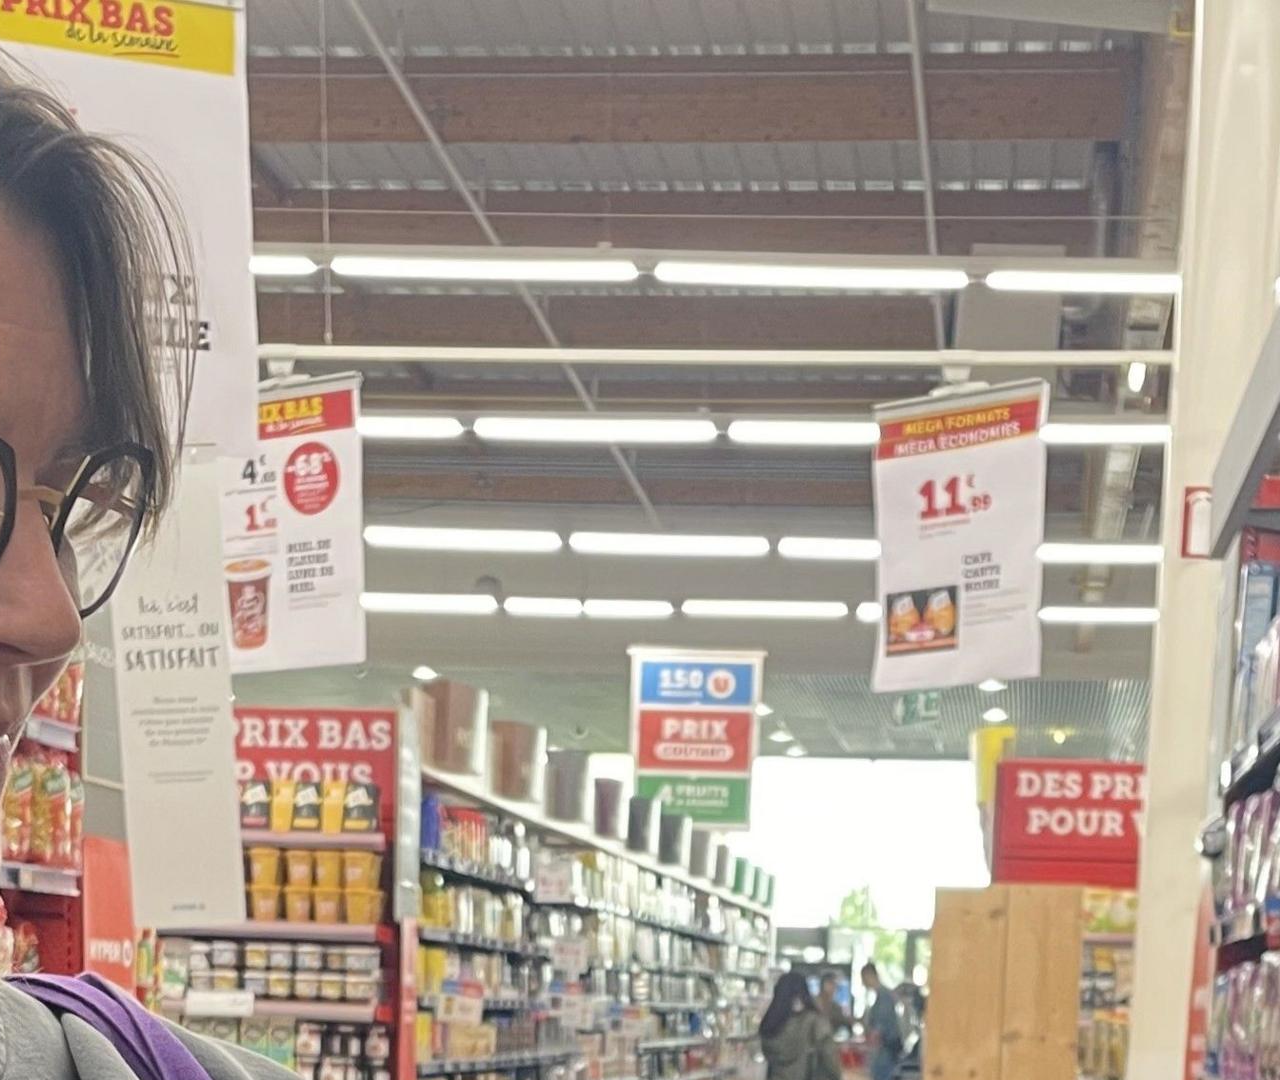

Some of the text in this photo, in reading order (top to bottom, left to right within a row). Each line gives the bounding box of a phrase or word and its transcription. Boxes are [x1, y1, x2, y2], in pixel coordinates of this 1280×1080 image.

[100, 0, 175, 36] BAS
[917, 475, 966, 520] 11
[125, 646, 221, 671] SATISFAIT
[317, 719, 392, 749] BAS
[662, 718, 728, 740] PRIX
[1016, 770, 1146, 800] DES PRI
[1026, 808, 1125, 836] POUR
